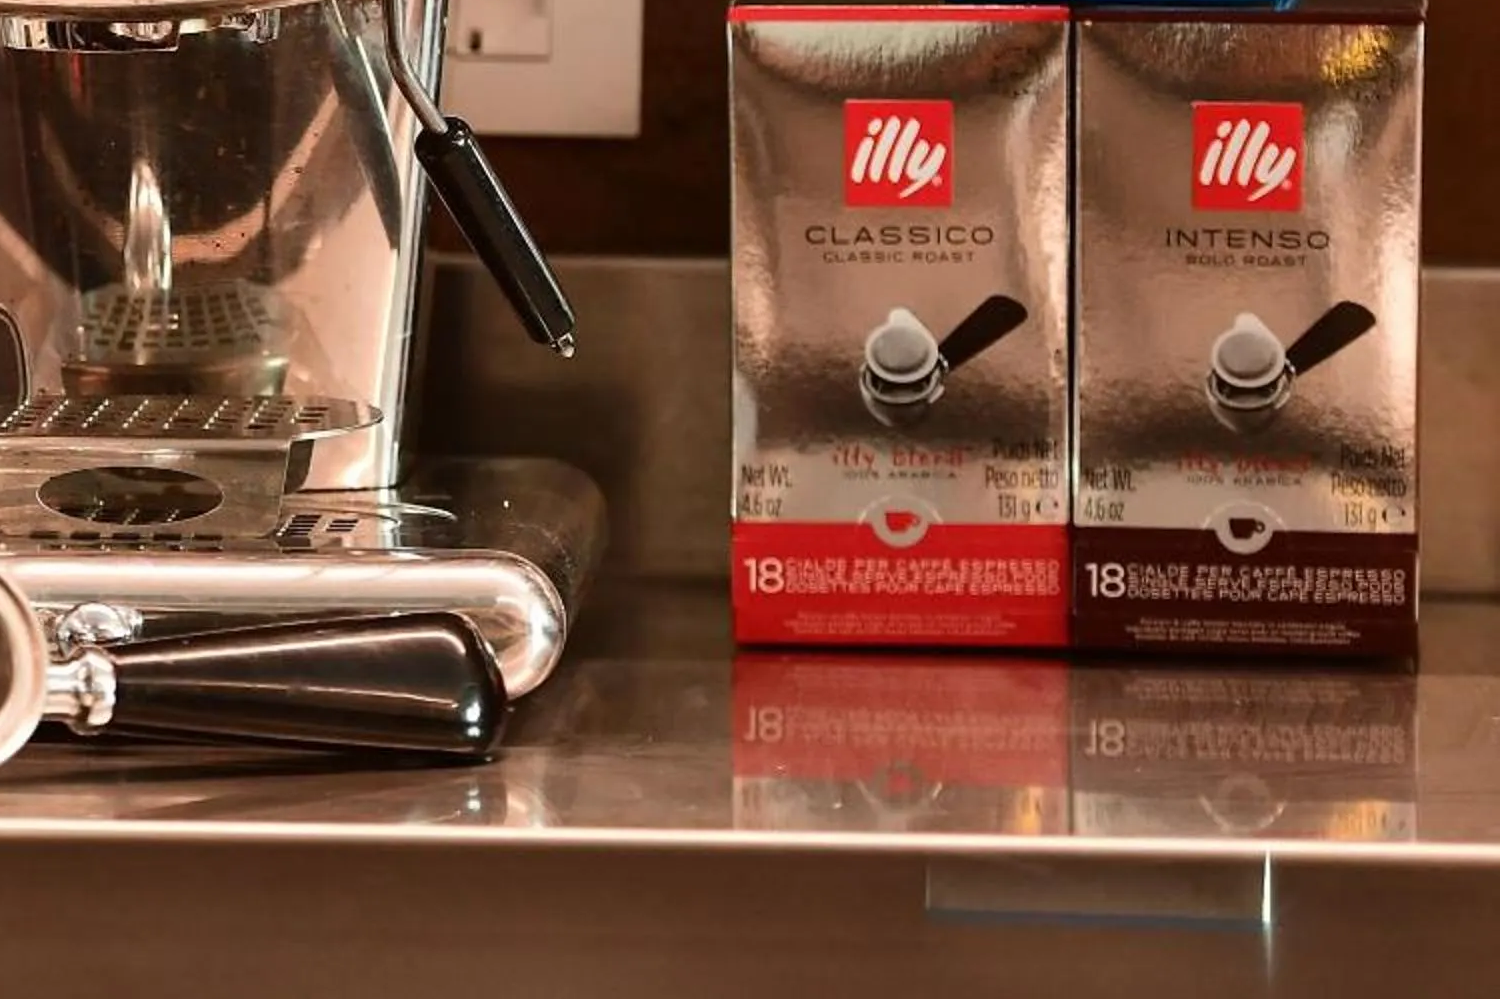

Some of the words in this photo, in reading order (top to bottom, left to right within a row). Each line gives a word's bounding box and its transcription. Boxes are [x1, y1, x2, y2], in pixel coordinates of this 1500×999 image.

[851, 115, 947, 199] illy
[1199, 118, 1297, 201] illy
[805, 225, 994, 246] CLASSICO
[1165, 228, 1330, 249] INTENSO
[823, 252, 905, 263] CLASSIC
[912, 252, 975, 263] ROAST
[741, 464, 765, 488] Net
[985, 466, 1018, 490] Peso
[743, 556, 785, 594] 18
[1084, 562, 1126, 599] 18
